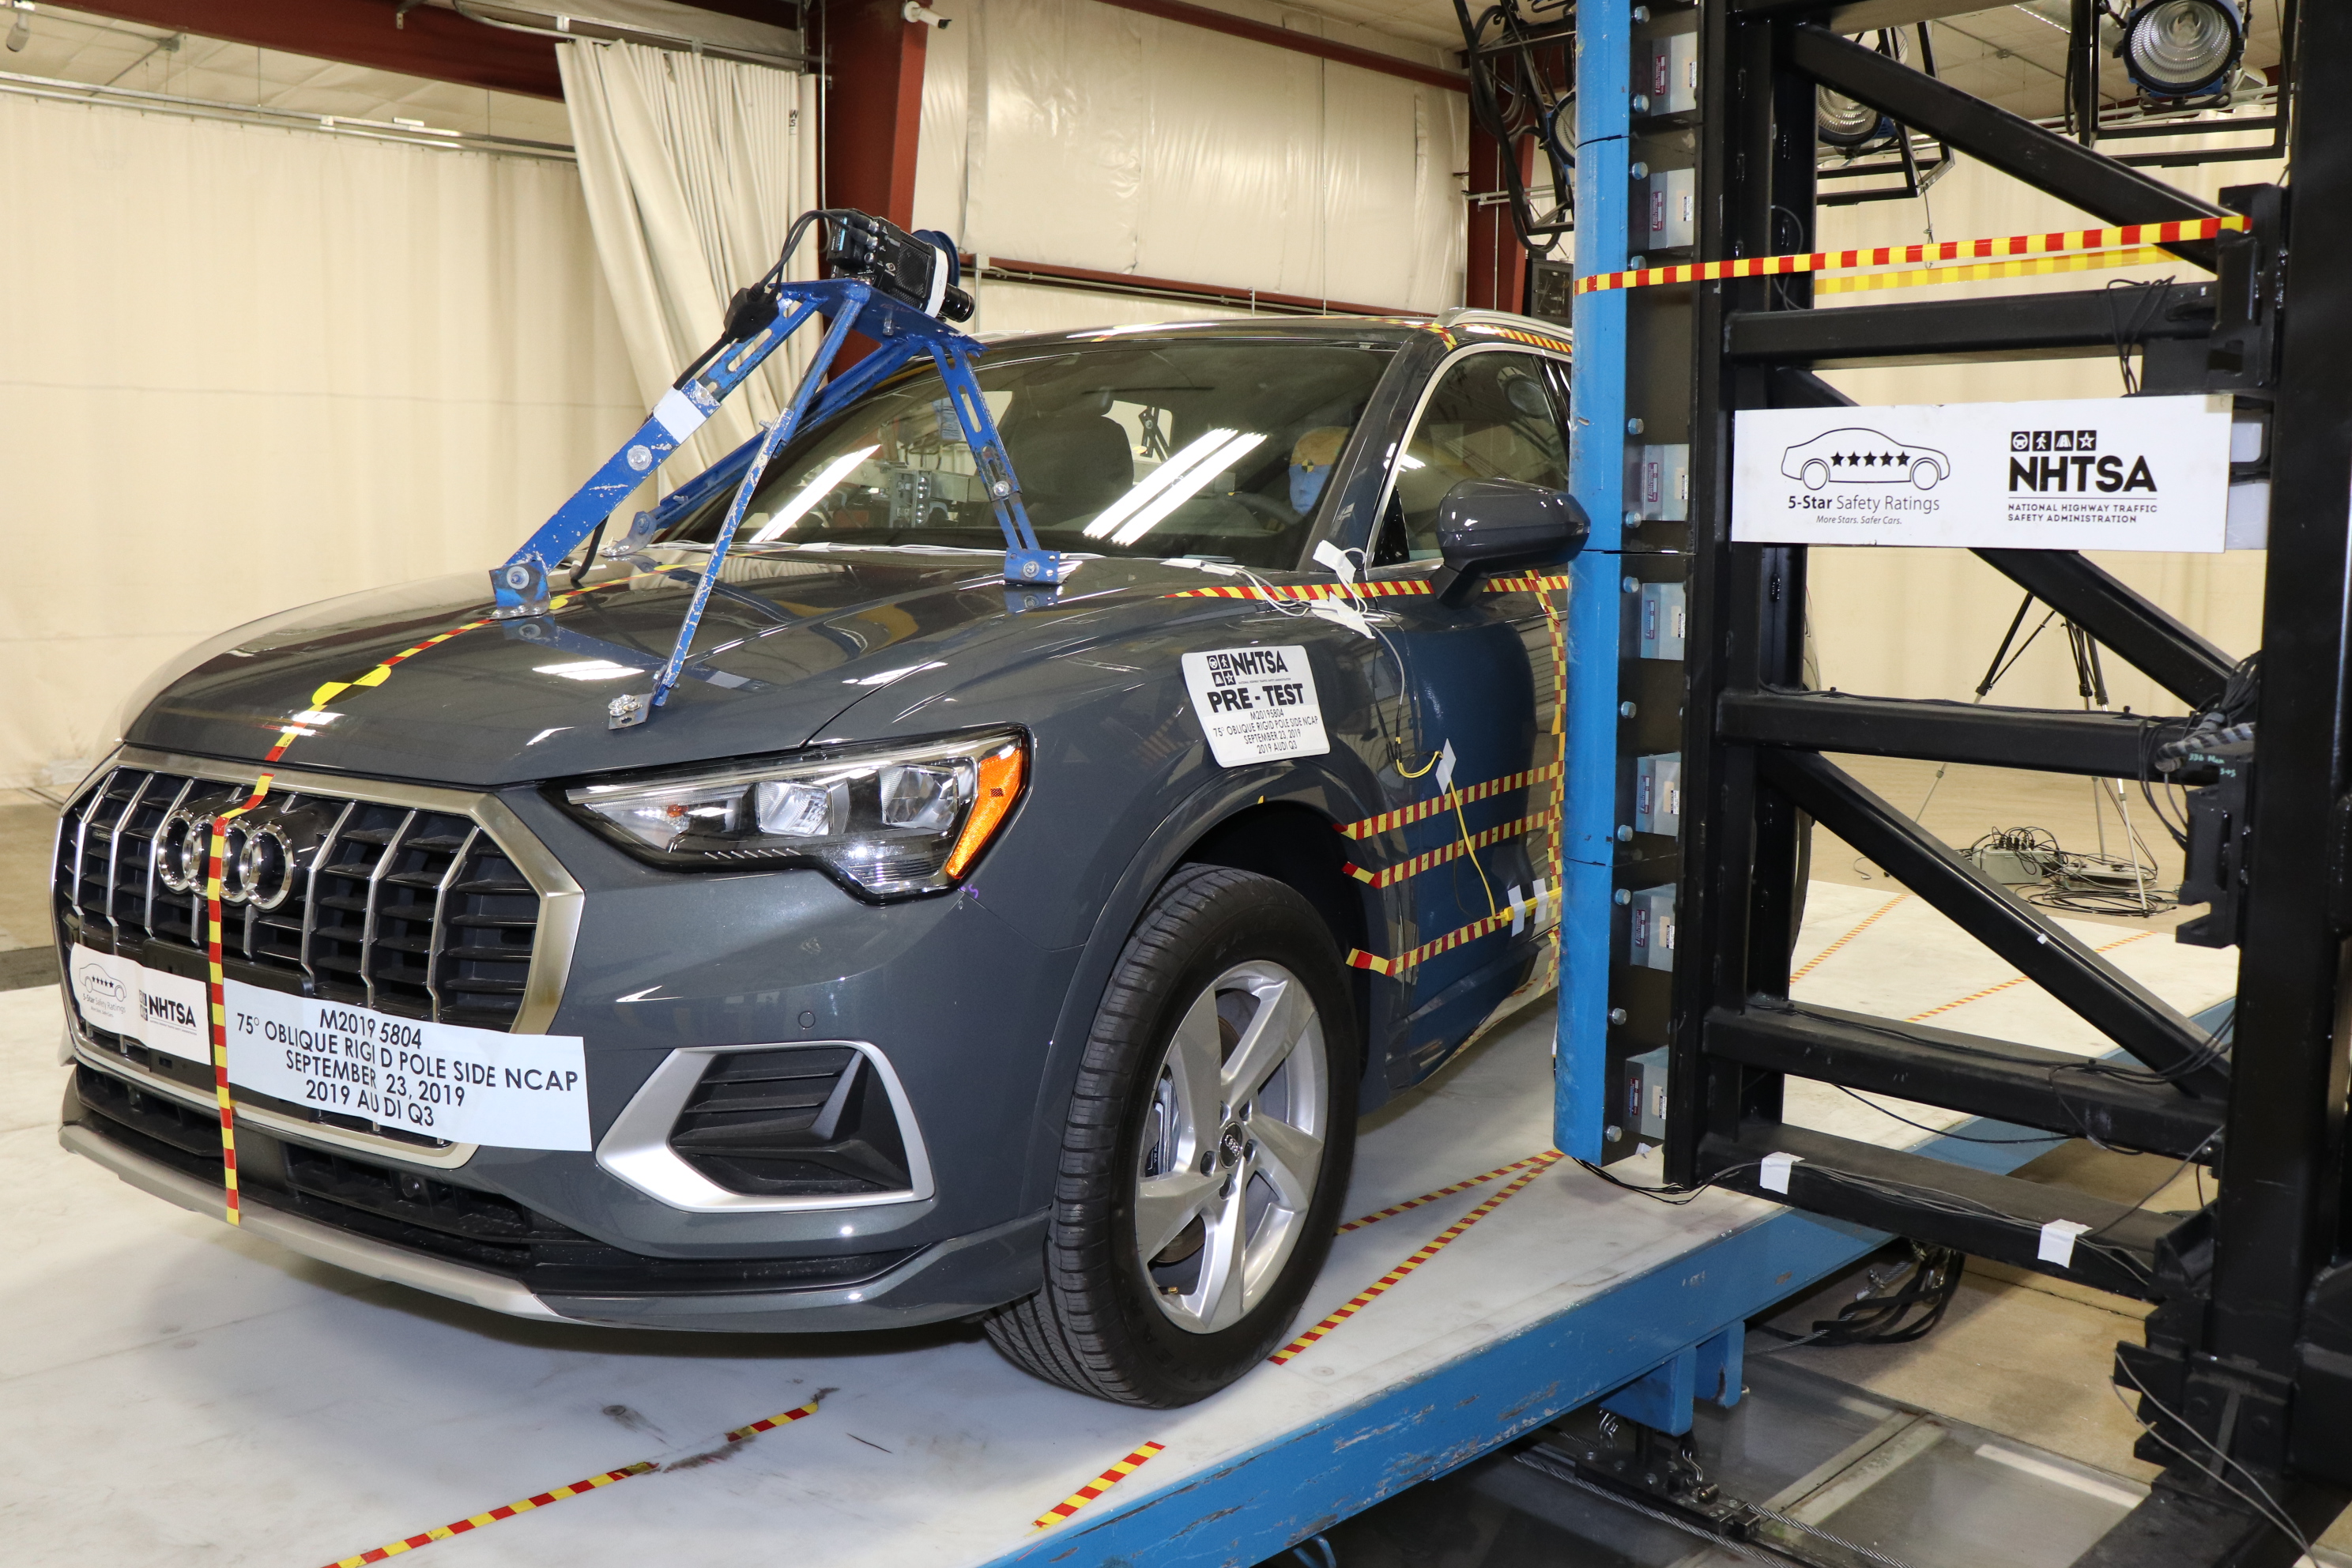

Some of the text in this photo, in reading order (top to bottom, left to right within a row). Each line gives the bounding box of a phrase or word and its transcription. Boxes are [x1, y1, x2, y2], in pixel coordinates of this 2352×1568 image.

[2009, 455, 2158, 492] NHTSA
[1788, 495, 1940, 514] 5-Star Safety Ratings
[1816, 515, 1902, 525] More Stars. Safer Cars.
[1230, 650, 1289, 676] NHTSA
[1207, 688, 1253, 713] PRE
[1262, 683, 1304, 707] TEST
[1227, 722, 1256, 735] OBLIQUE
[1257, 720, 1275, 732] RIGID
[1275, 718, 1290, 729] POLE
[1291, 717, 1302, 728] SIDE
[1302, 715, 1319, 726] NCAP
[1250, 708, 1284, 721] M20195804
[1244, 729, 1302, 745] SEPTEMBER 23, 2019
[1257, 740, 1298, 754] 2019 AUDI Q3
[95, 997, 107, 1010] Safety
[107, 1001, 126, 1015] Ratings
[149, 994, 197, 1027] NHTSA
[265, 1020, 338, 1055] OBLIQUE
[399, 1051, 446, 1079] POLE
[453, 1060, 496, 1087] SIDE
[505, 1068, 578, 1091] NCAP
[286, 1050, 465, 1107] SEPTEMBER 23, 2019
[306, 1080, 350, 1105] 2019
[408, 1102, 435, 1127] Q3
